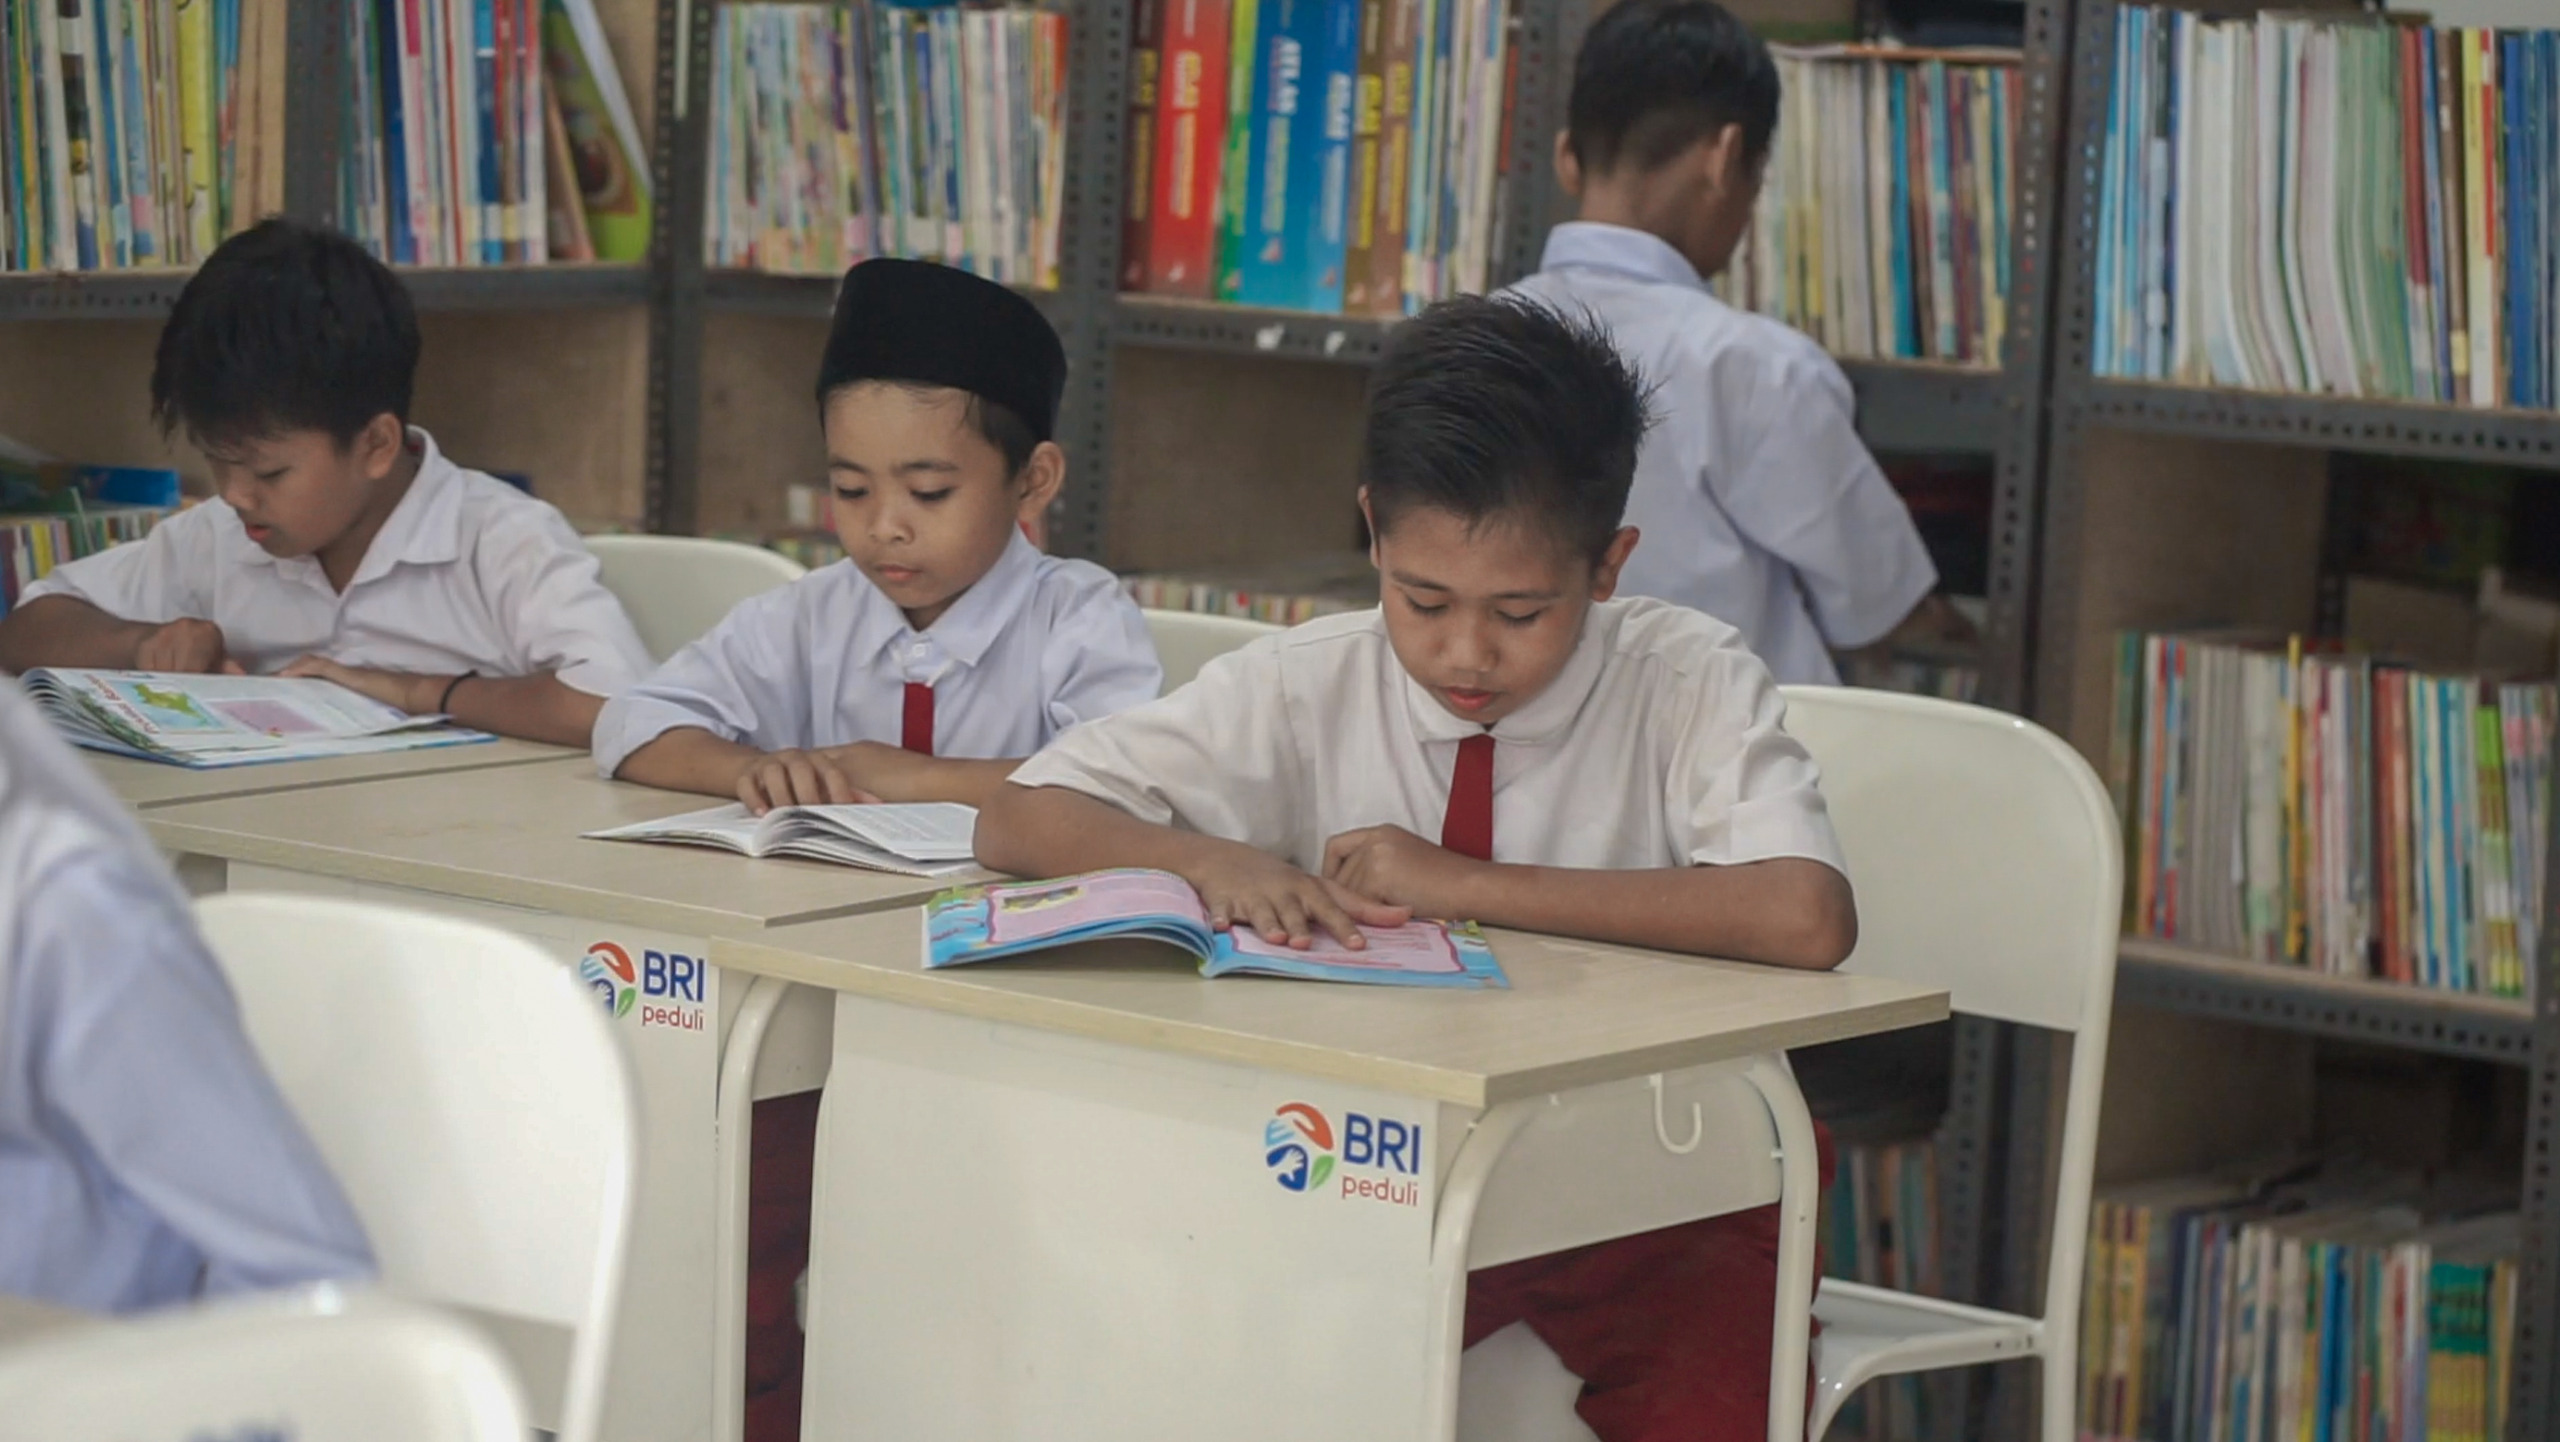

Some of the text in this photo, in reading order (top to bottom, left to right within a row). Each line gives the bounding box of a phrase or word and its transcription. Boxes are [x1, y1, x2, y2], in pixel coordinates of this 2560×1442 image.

[643, 949, 704, 1002] BRI
[642, 1005, 704, 1031] peduli
[1343, 1112, 1420, 1175] BRI
[1342, 1175, 1418, 1207] peduli
